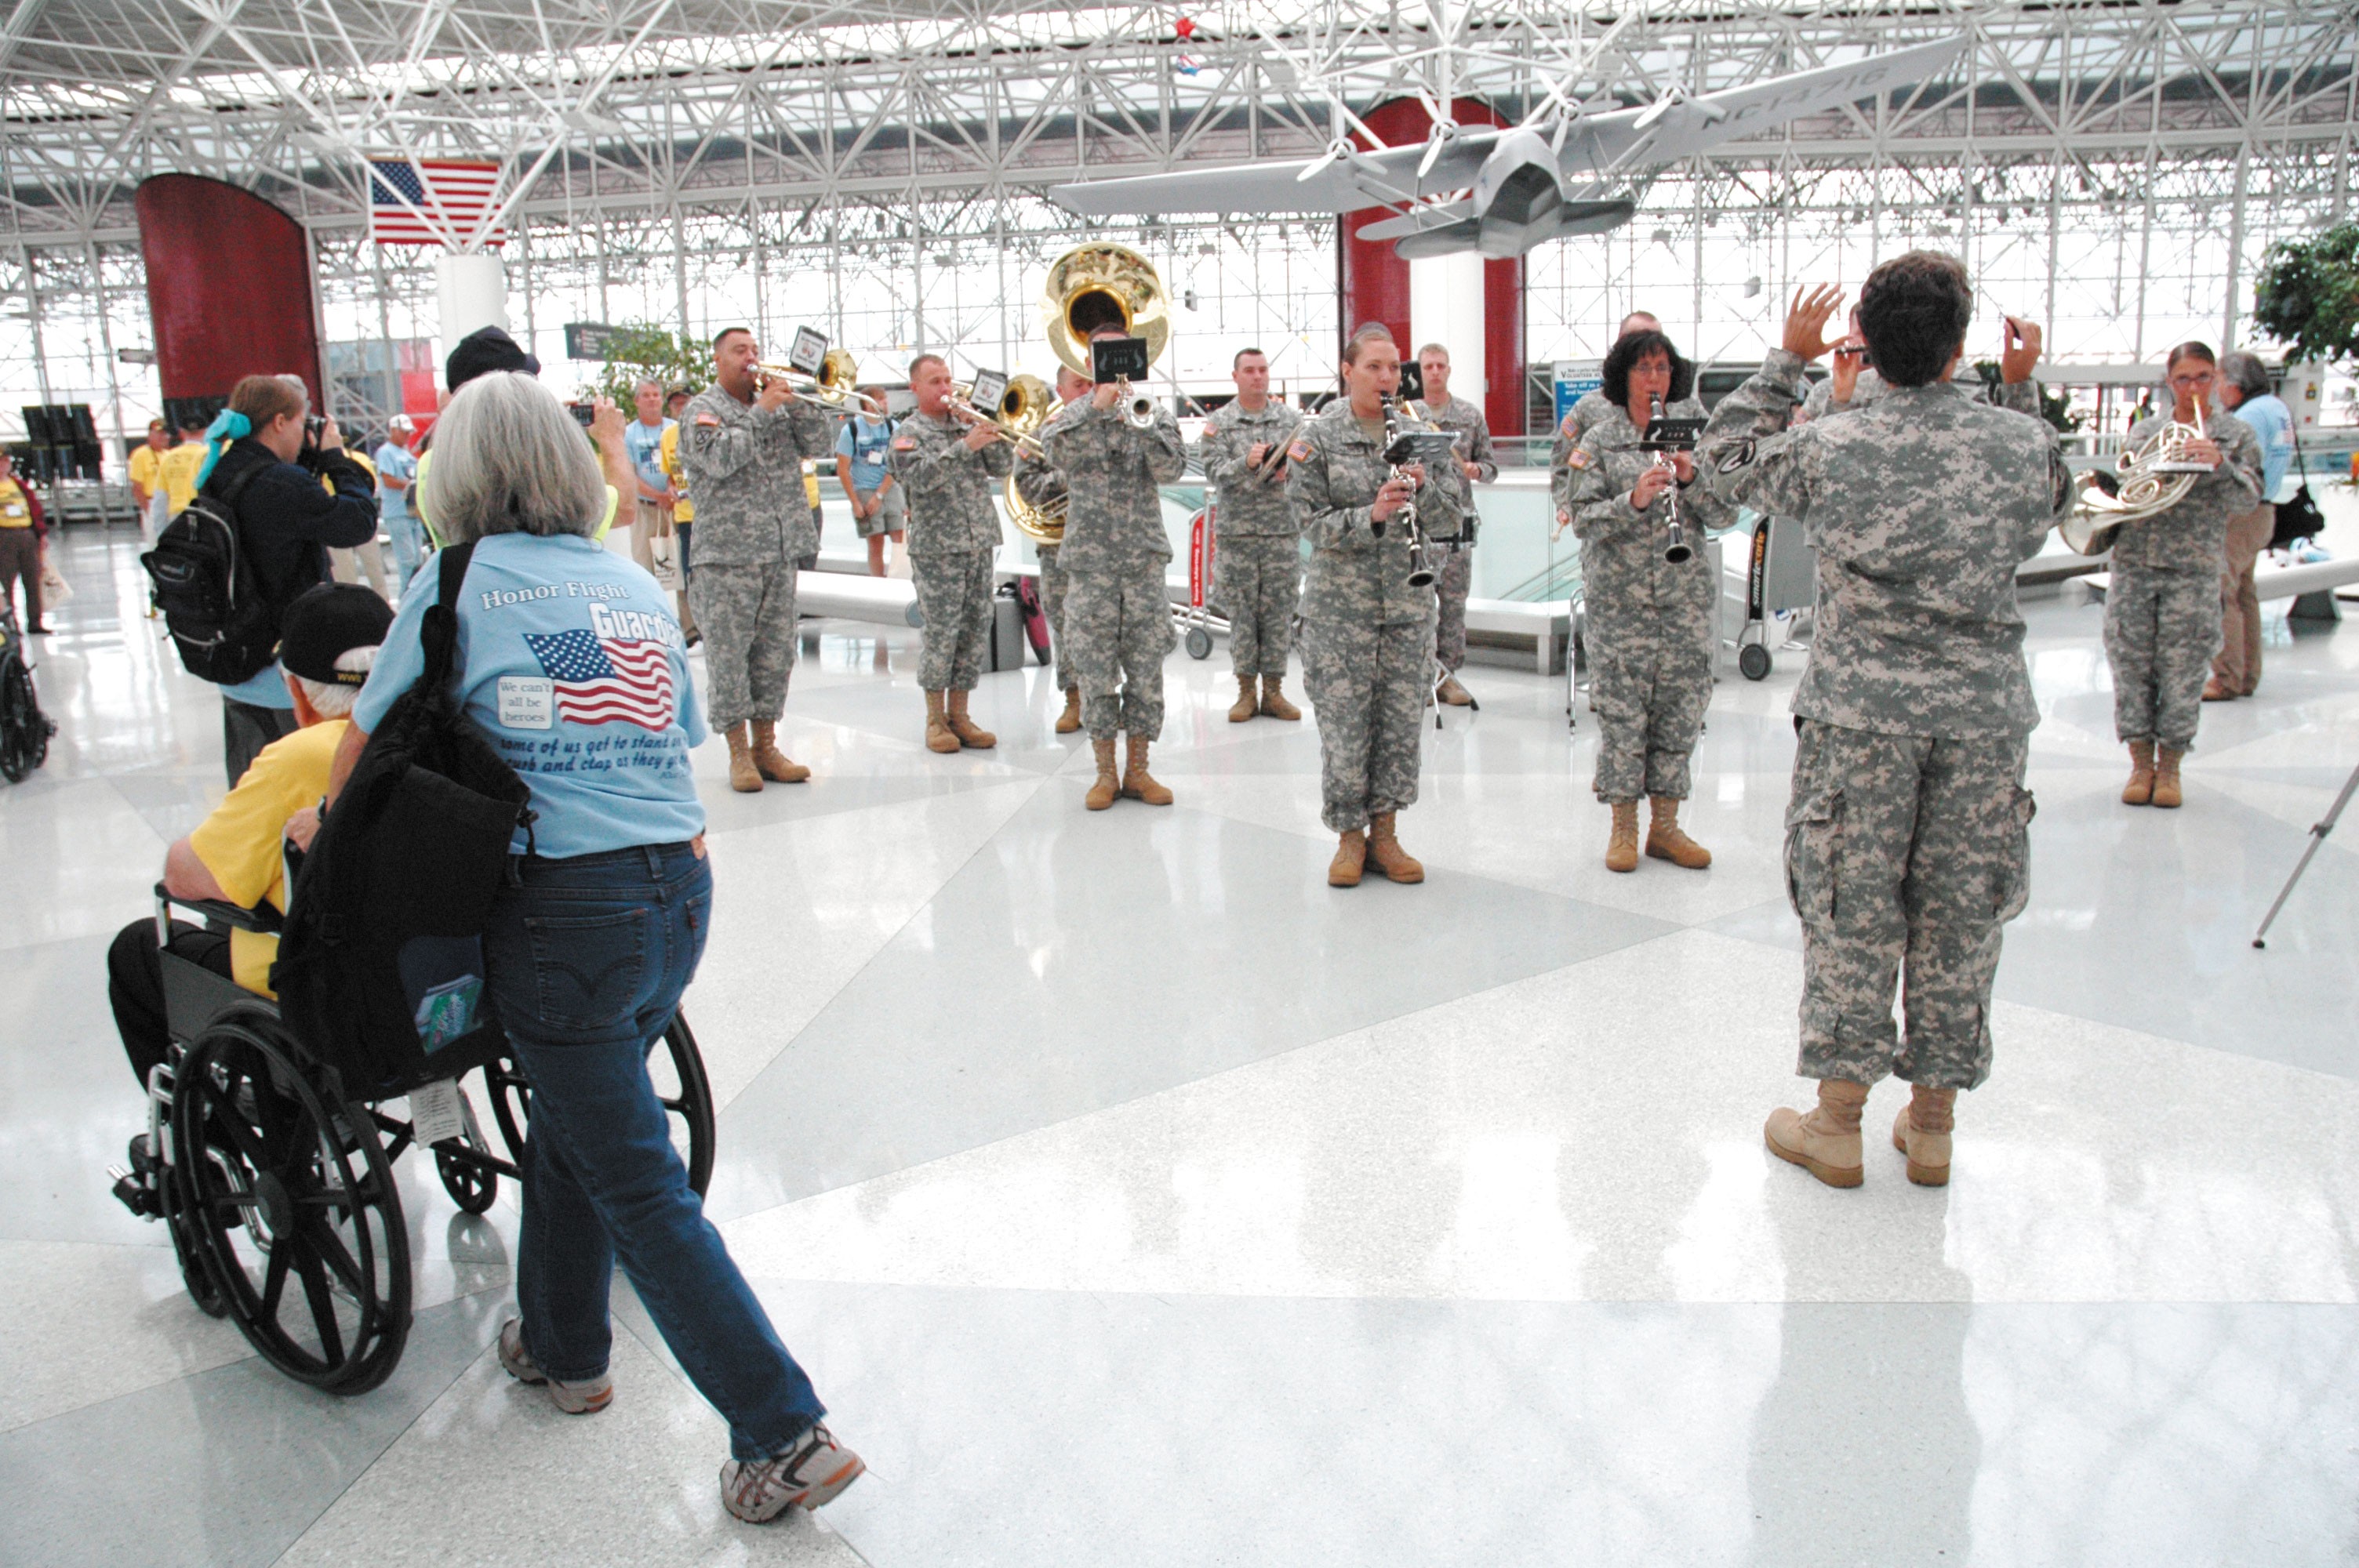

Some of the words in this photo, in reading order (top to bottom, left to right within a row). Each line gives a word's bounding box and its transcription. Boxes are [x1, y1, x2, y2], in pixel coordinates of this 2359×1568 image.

[482, 586, 559, 610] Honor
[565, 582, 631, 601] Flight
[500, 682, 517, 691] We
[521, 682, 550, 692] can't
[508, 697, 523, 706] all
[526, 697, 541, 707] be
[505, 711, 546, 721] heroes
[540, 738, 559, 757] of
[563, 742, 580, 753] us
[586, 734, 610, 757] get
[614, 735, 628, 750] to
[631, 735, 668, 749] stand
[542, 756, 576, 772] and
[580, 757, 612, 772] clap
[616, 757, 628, 768] as
[633, 751, 664, 769] they
